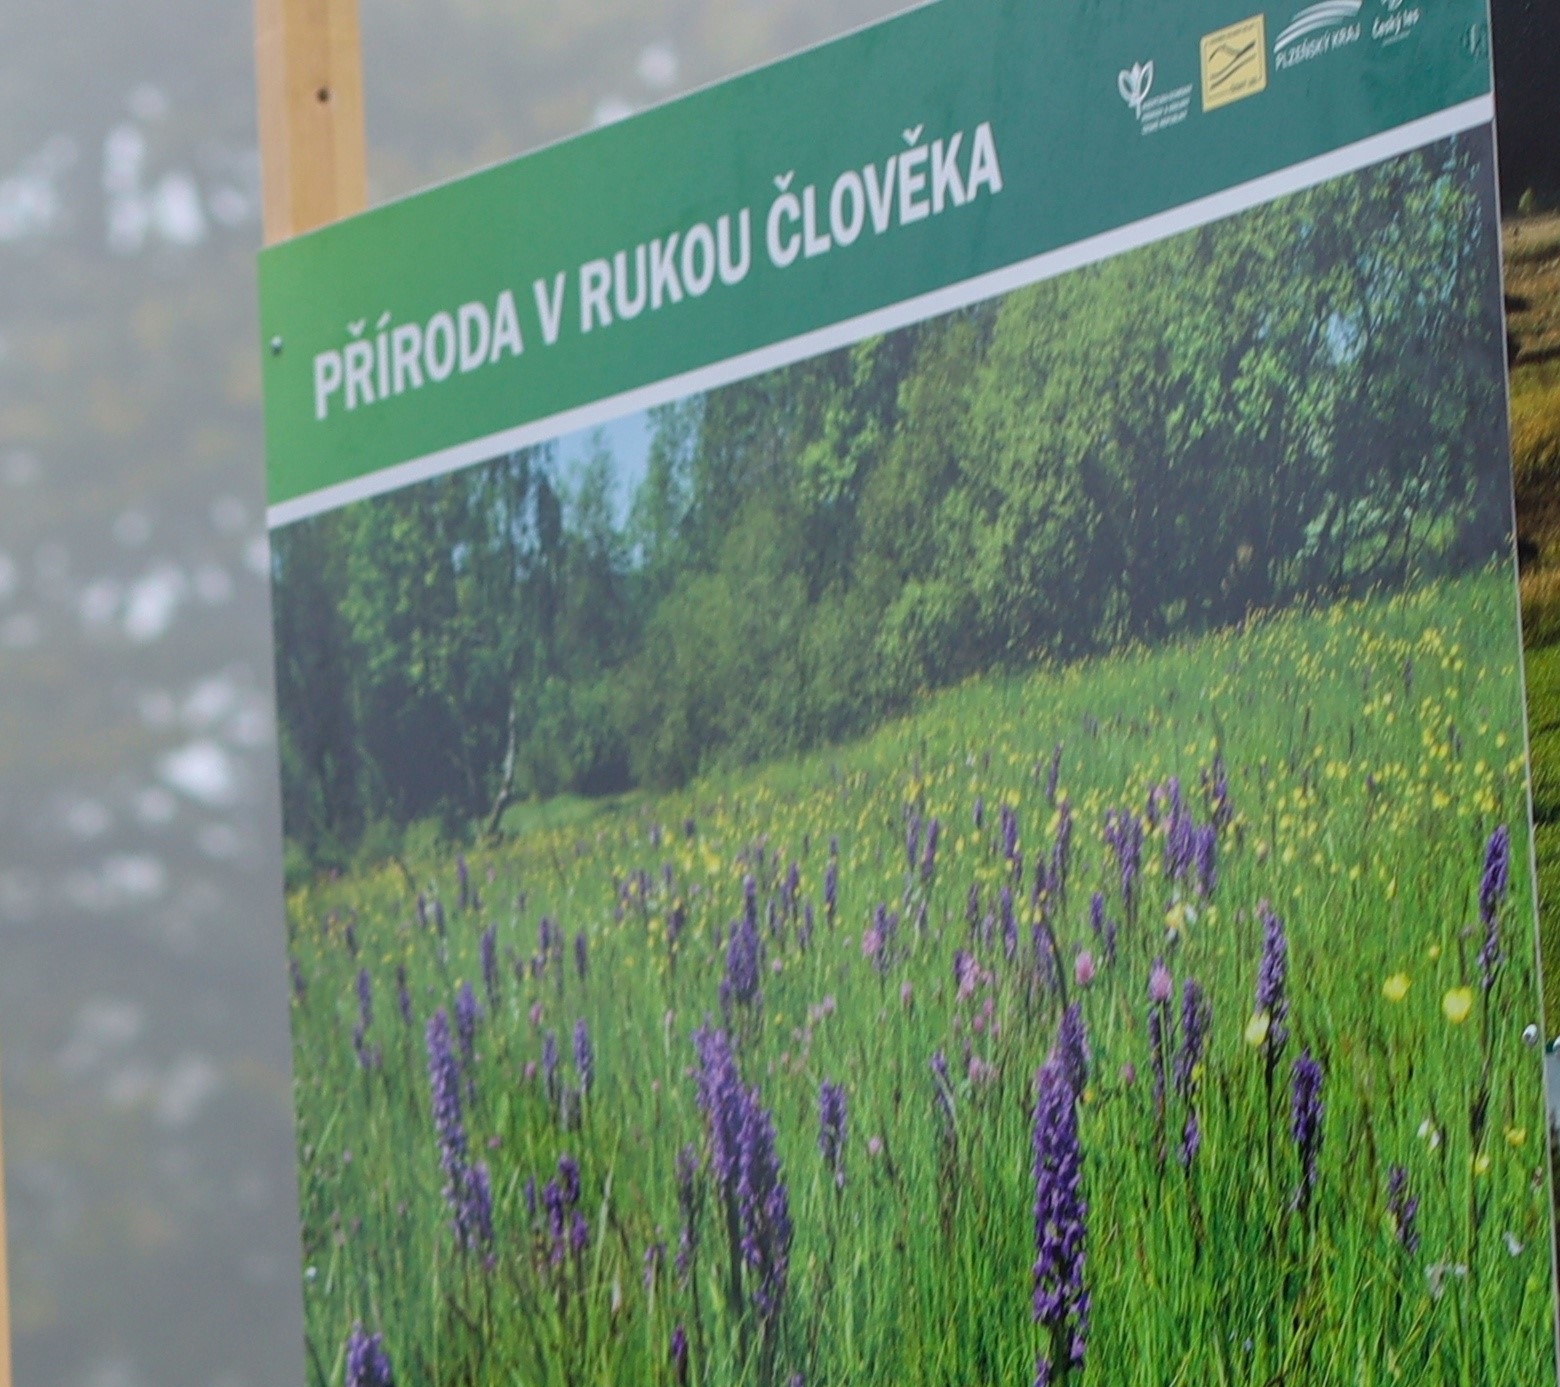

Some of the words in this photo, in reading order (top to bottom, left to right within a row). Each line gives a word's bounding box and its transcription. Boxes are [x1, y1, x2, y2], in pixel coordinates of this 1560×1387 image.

[313, 290, 527, 425] PŘÍRODA
[533, 272, 566, 345] V
[579, 211, 750, 332] RUKOU
[766, 122, 1007, 272] ČLOVĚKA
